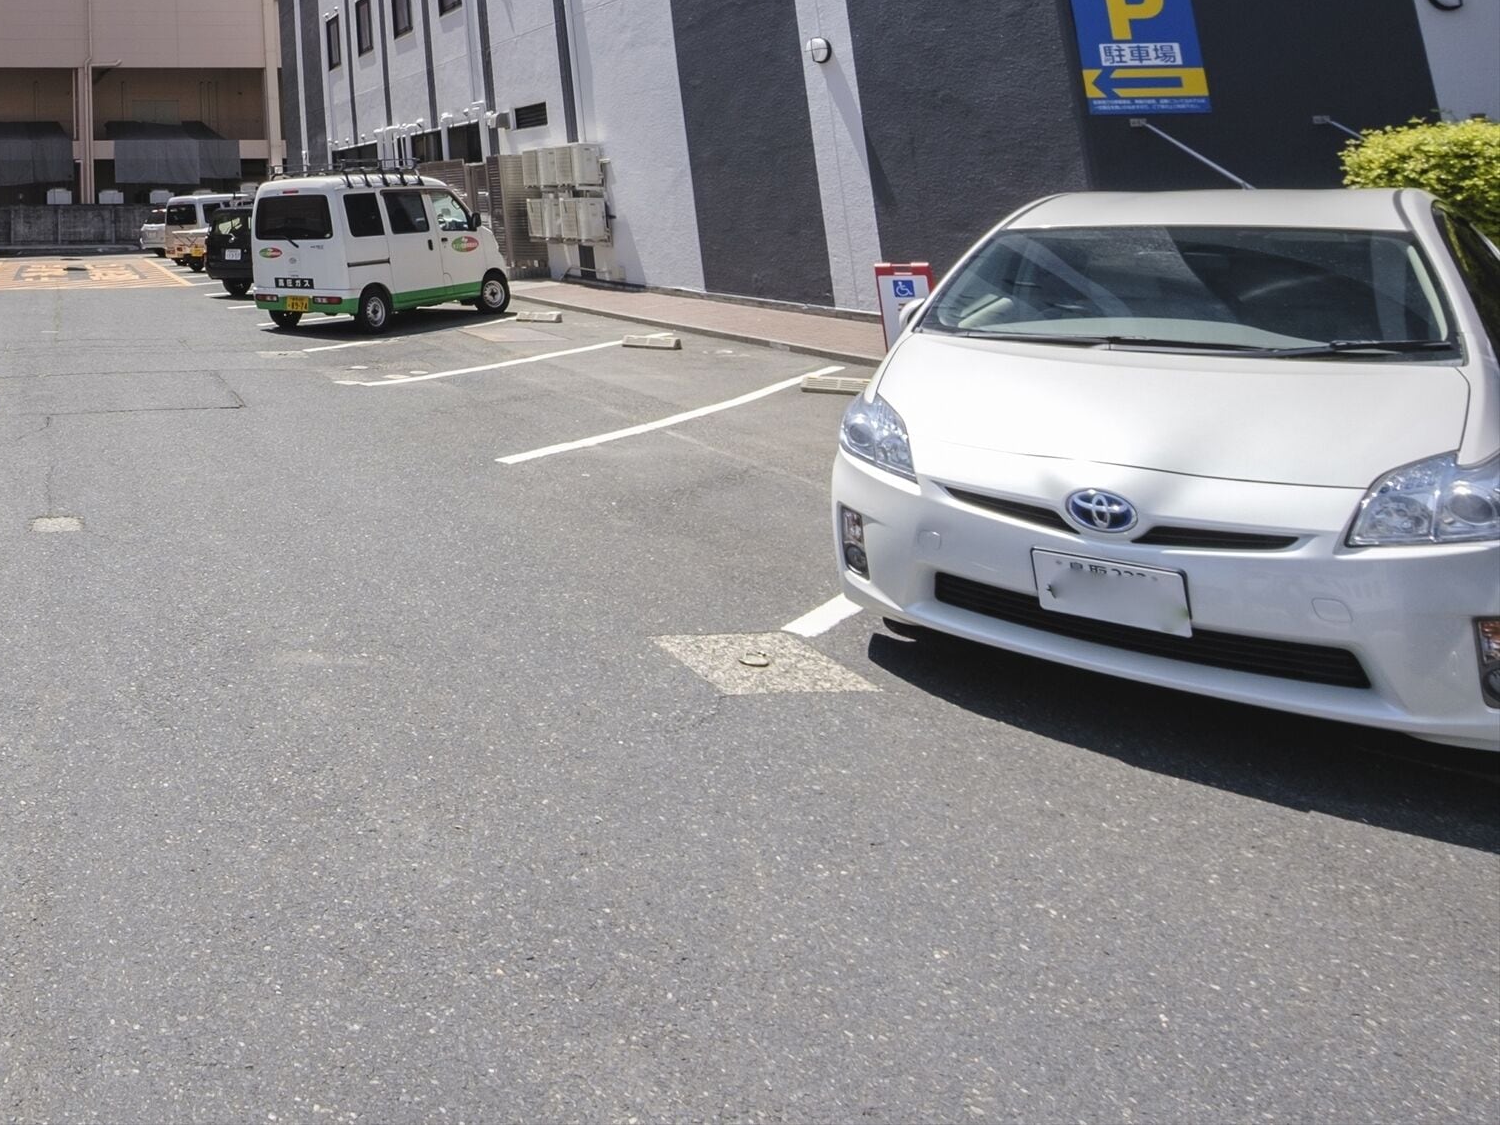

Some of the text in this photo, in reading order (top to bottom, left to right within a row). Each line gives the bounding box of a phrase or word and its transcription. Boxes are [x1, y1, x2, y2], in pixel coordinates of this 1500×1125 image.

[1103, 44, 1177, 64] 駐車場
[278, 278, 310, 287] 高圧ガス
